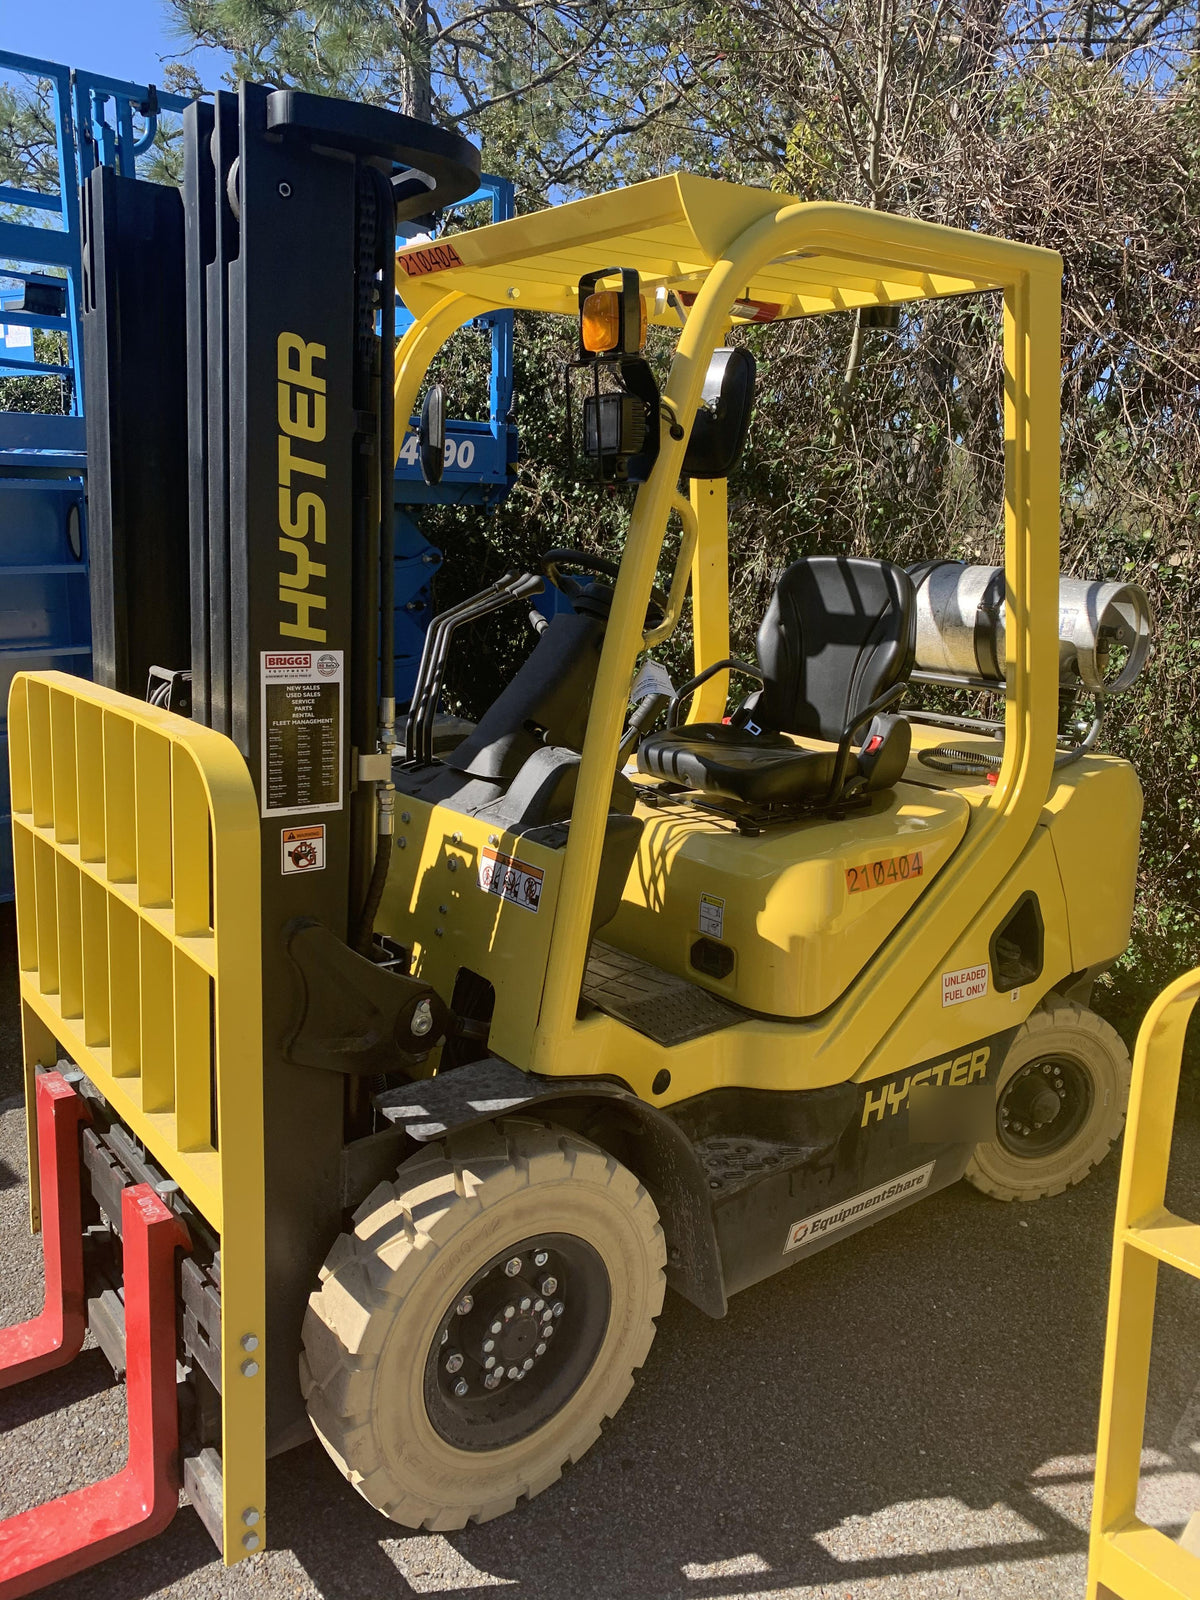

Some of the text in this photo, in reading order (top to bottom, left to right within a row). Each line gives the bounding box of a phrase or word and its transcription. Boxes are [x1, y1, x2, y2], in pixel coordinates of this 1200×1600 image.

[399, 244, 462, 276] 210404
[400, 437, 475, 469] 490
[277, 331, 327, 643] HYSTER
[268, 656, 309, 666] BRIGGS
[847, 852, 923, 892] 210404
[944, 968, 987, 988] UNLEADED
[944, 982, 987, 1003] FUEL ONLY
[809, 1173, 925, 1235] EquipmentShare
